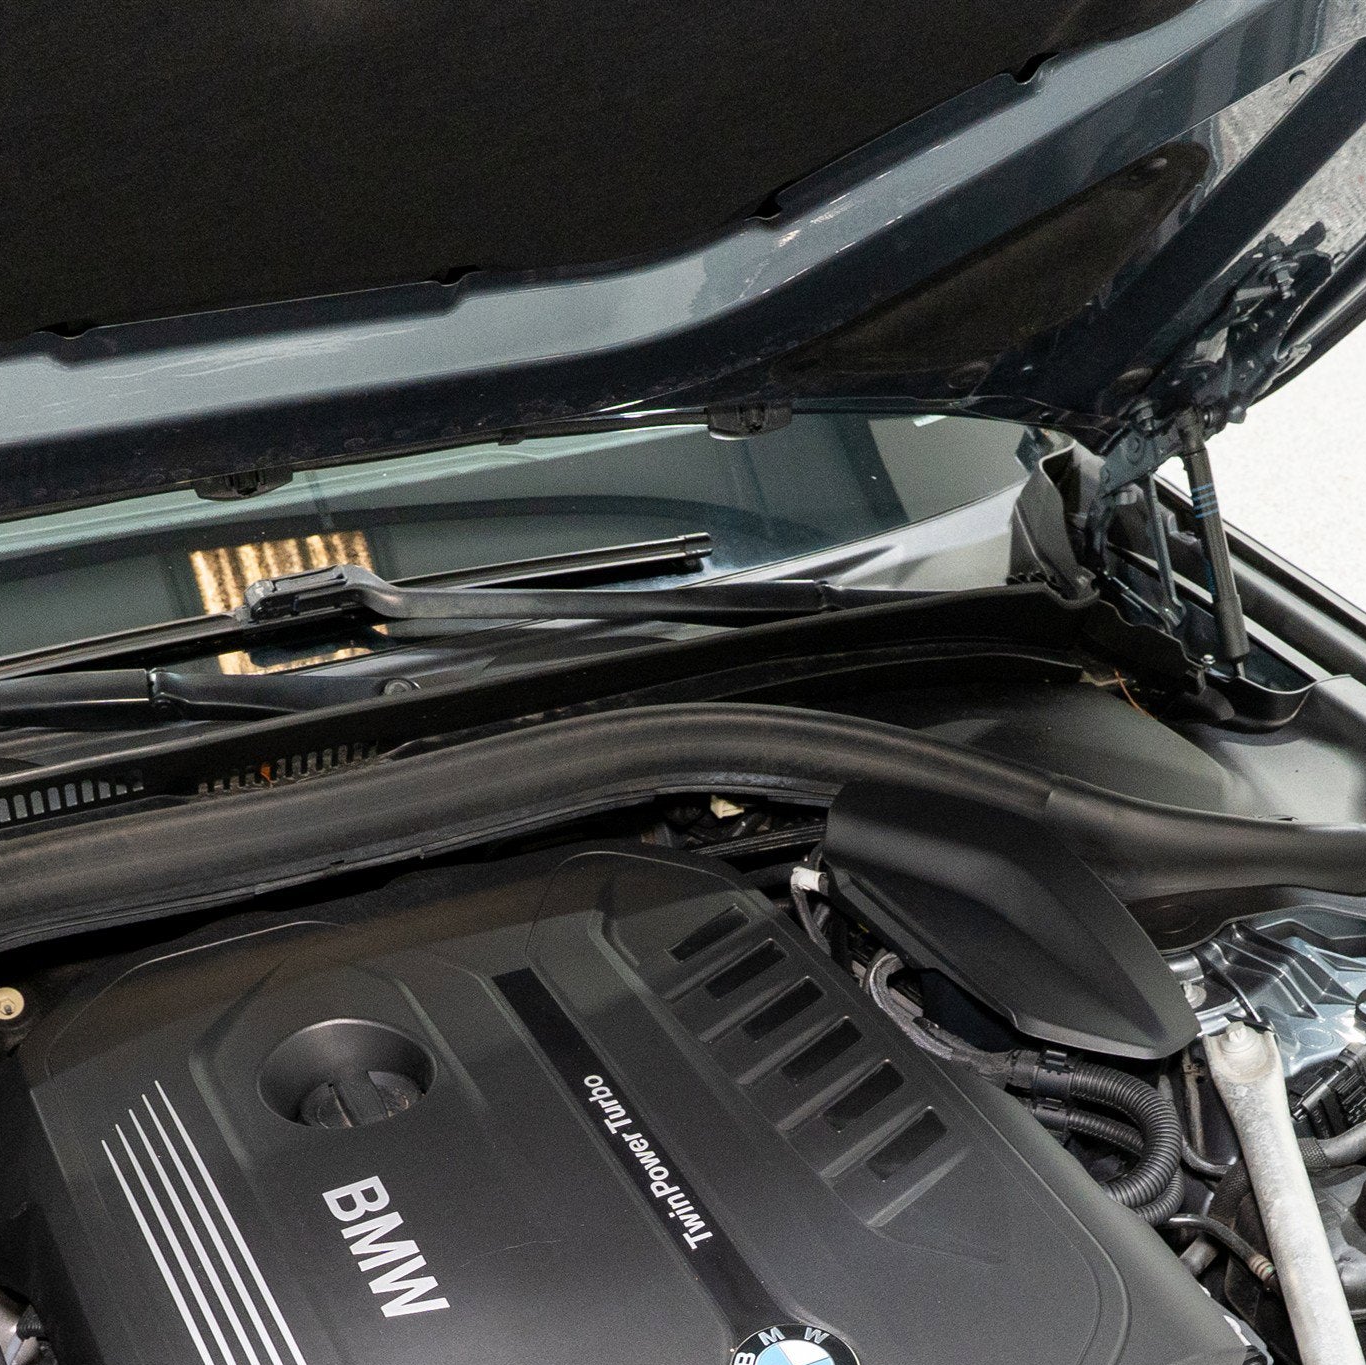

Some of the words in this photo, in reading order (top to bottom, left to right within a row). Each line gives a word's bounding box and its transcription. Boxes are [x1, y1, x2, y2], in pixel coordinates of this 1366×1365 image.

[584, 1074, 632, 1134] Turbo
[321, 1175, 451, 1318] BMW
[621, 1132, 713, 1250] TwinPower
